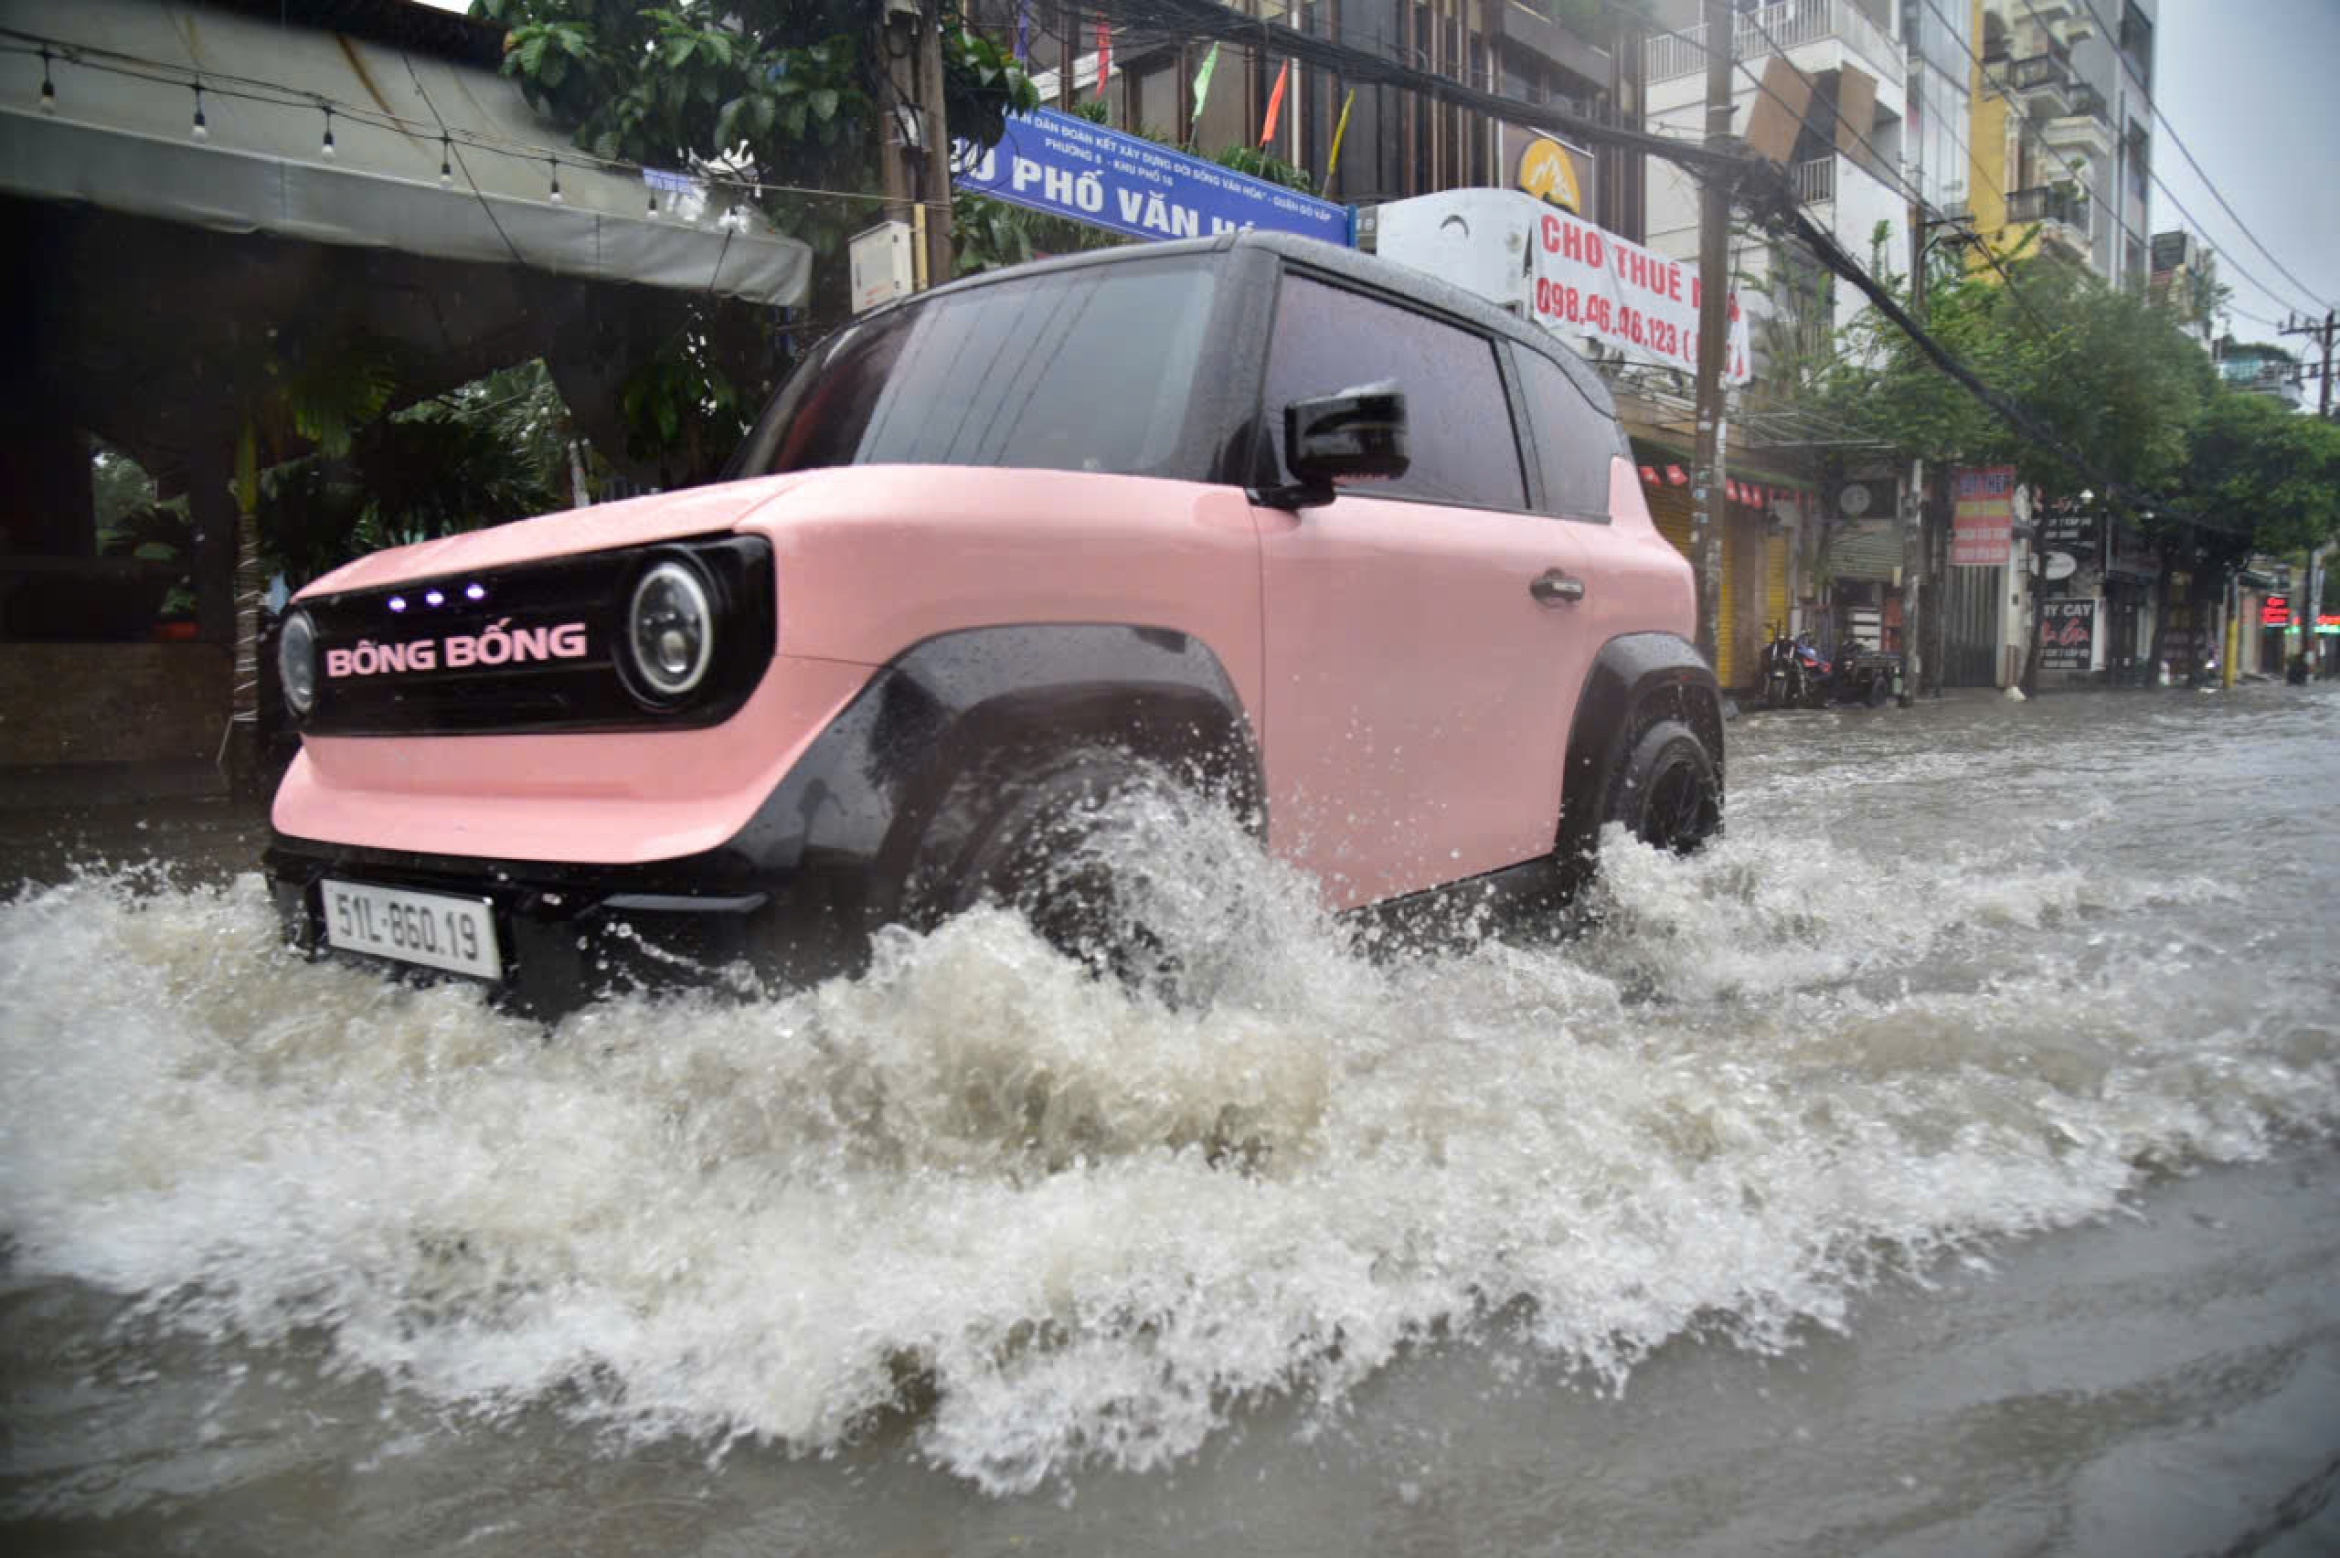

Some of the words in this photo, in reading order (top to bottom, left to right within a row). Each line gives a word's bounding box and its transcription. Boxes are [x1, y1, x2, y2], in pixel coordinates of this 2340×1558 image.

[1012, 155, 1105, 214] PHỐ
[1117, 188, 1200, 238] VĂN
[1540, 213, 1604, 269] CHO
[1613, 244, 1683, 303] THUÊ
[1536, 277, 1677, 356] 098.46.46.123
[444, 617, 587, 668] BỐNG
[336, 893, 479, 961] 51L-860.19
